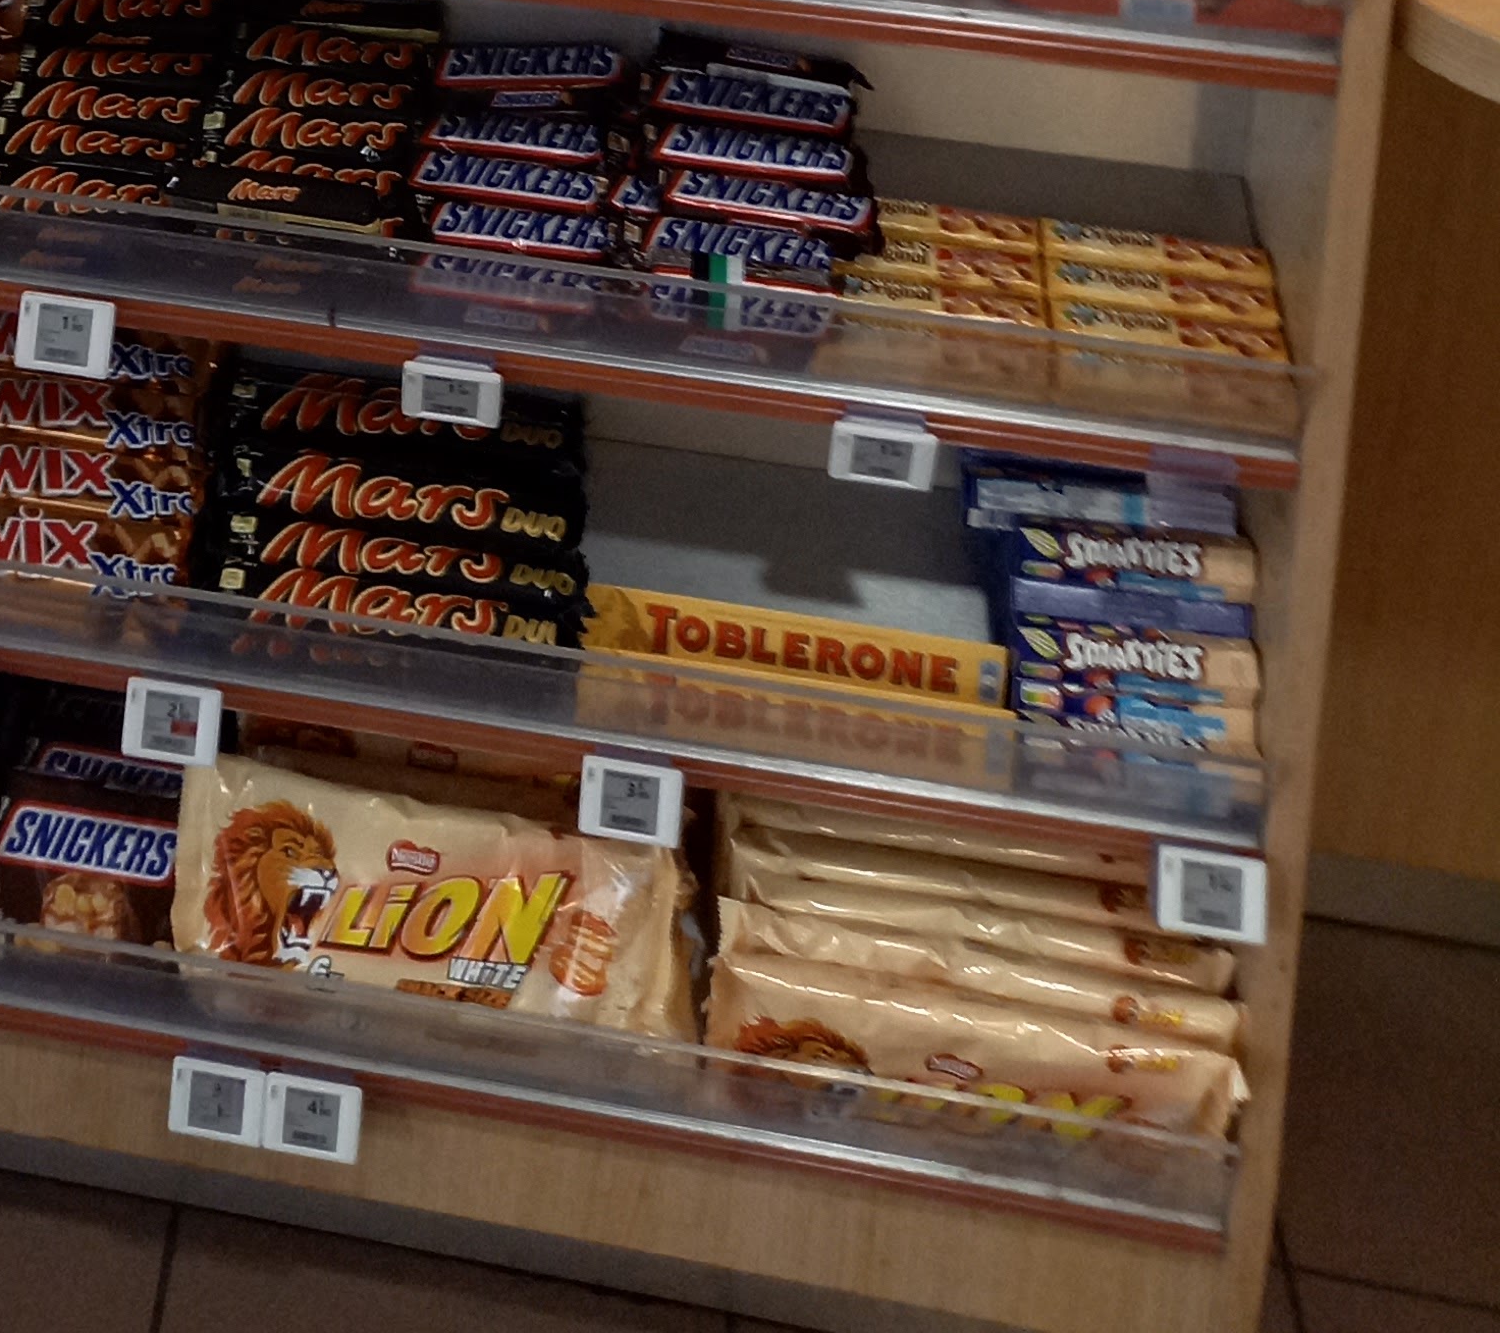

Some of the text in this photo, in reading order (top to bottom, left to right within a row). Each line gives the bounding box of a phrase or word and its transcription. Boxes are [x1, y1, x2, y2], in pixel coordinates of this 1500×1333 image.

[37, 47, 211, 79] Mars
[246, 24, 424, 70] Mars
[447, 44, 623, 78] SNICKERS
[22, 79, 200, 124] Mars
[233, 69, 412, 110] Mars
[666, 71, 848, 123] SNICKERS
[4, 119, 178, 161] Mars
[224, 106, 406, 151] Mars
[434, 113, 601, 155] SNICKERS
[669, 124, 848, 171] SNICKERS
[421, 151, 597, 201] SNICKERS
[681, 171, 873, 222] SNICKERS
[437, 201, 610, 248] SNICKERS
[657, 218, 834, 269] SNICKERS
[111, 342, 194, 380] Xtra
[106, 408, 194, 449] Xtra
[107, 478, 196, 521] Xtra
[257, 449, 568, 543] Mars DUO
[260, 521, 578, 596] Mars DUO
[249, 568, 508, 636] Mars
[645, 602, 961, 694] TOBLERONE
[45, 750, 184, 795] SNICKER
[4, 811, 178, 881] SNICKERS
[319, 871, 574, 965] LION
[449, 957, 528, 989] WHITE
